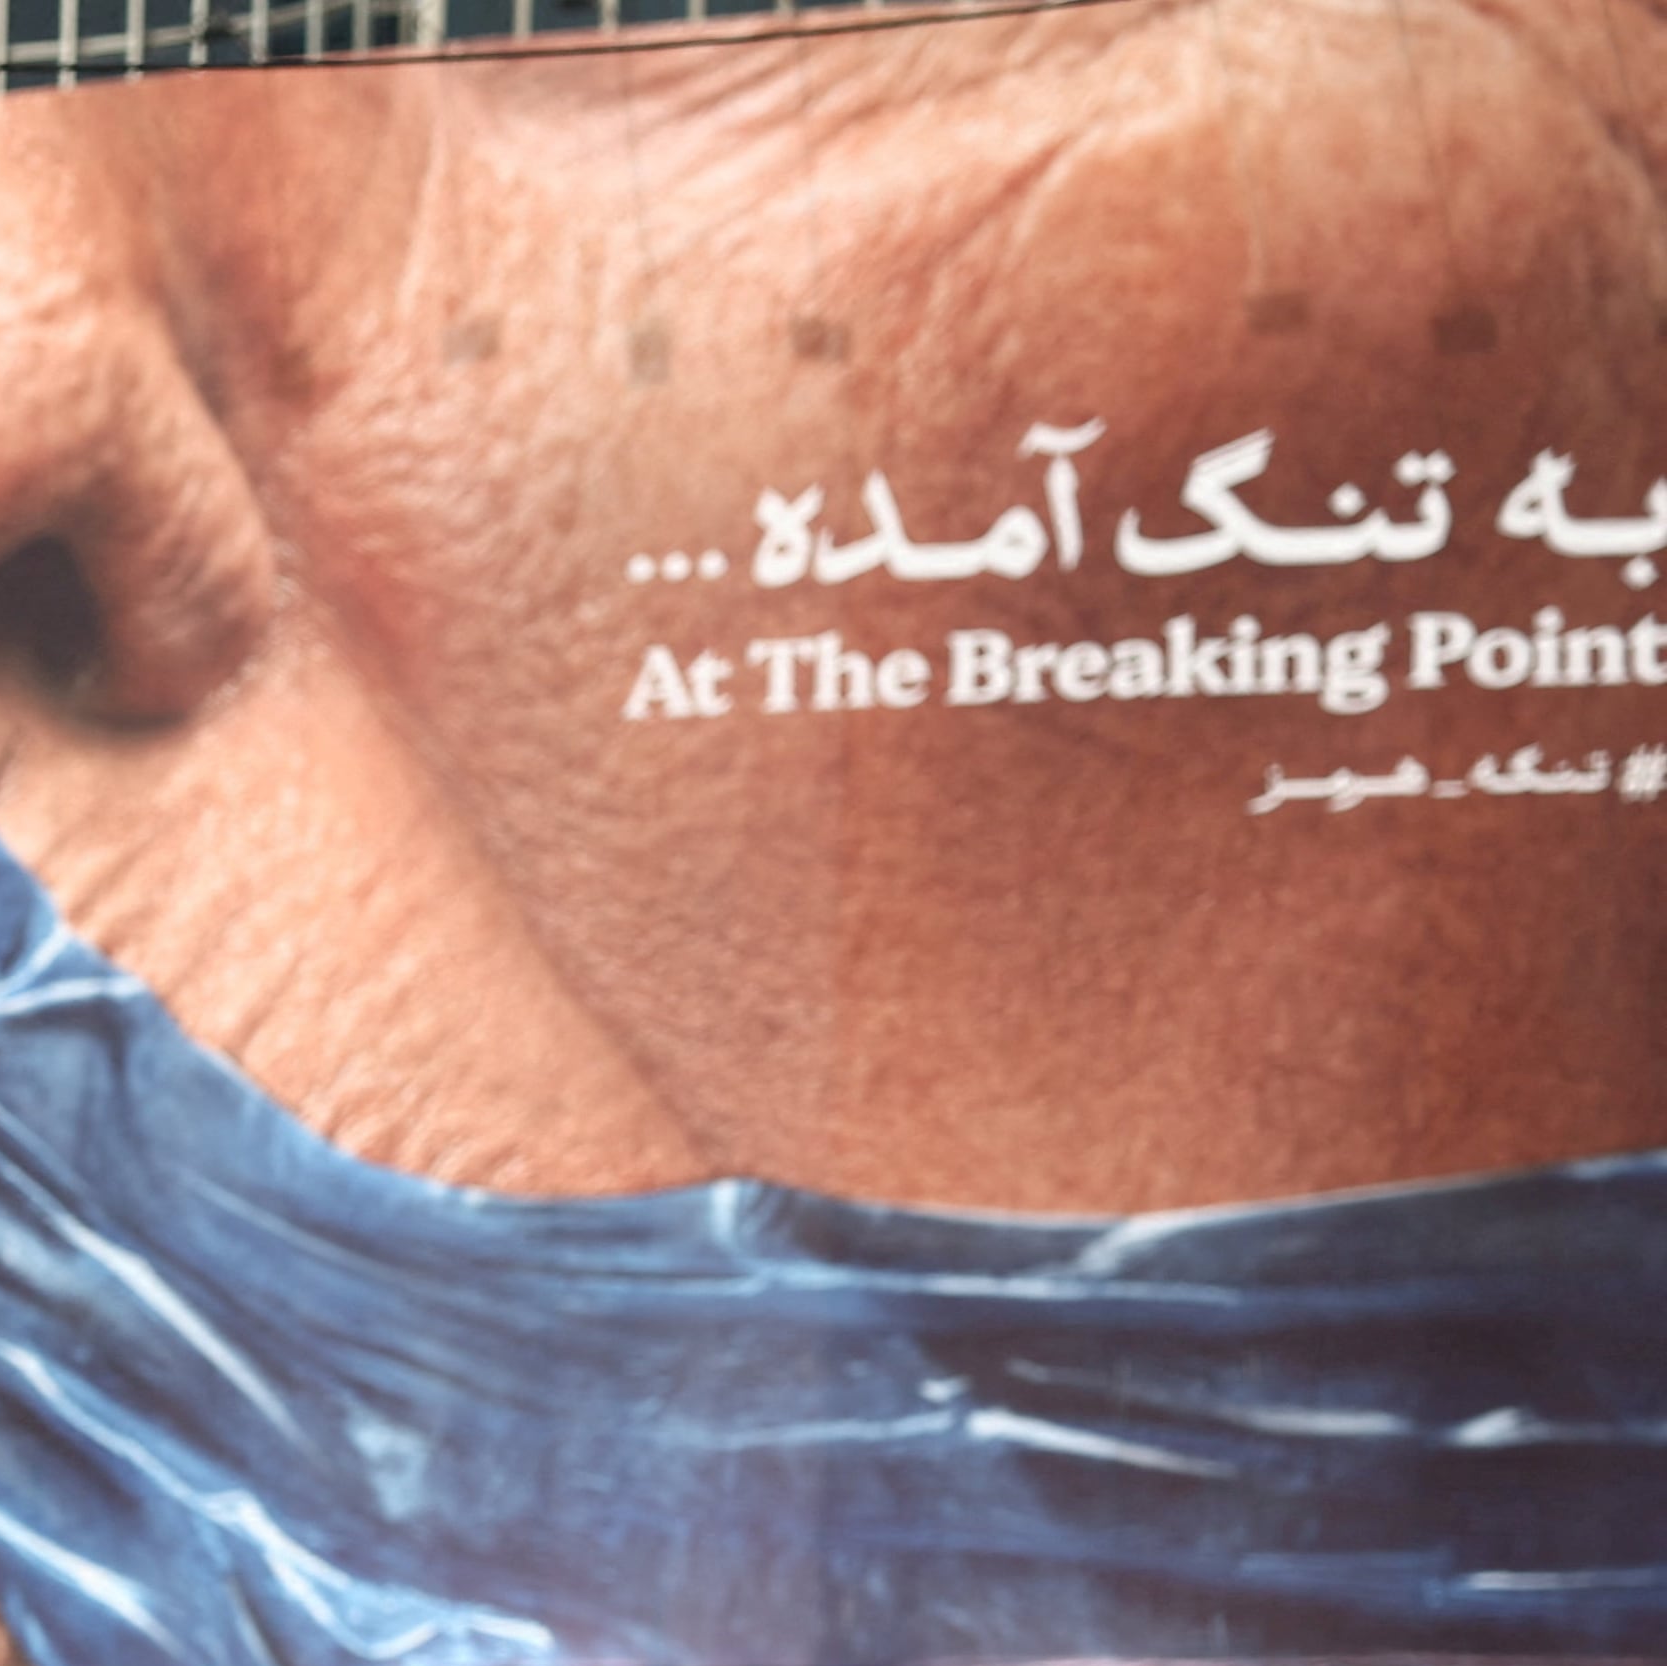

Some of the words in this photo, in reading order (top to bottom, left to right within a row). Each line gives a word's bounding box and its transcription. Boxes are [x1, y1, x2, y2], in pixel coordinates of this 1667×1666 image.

[1114, 427, 1458, 577] تنگ
[1495, 446, 1667, 590] به
[620, 643, 733, 720] At
[745, 629, 934, 715] The
[946, 612, 1392, 716] Breaking
[1406, 605, 1667, 690] Point
